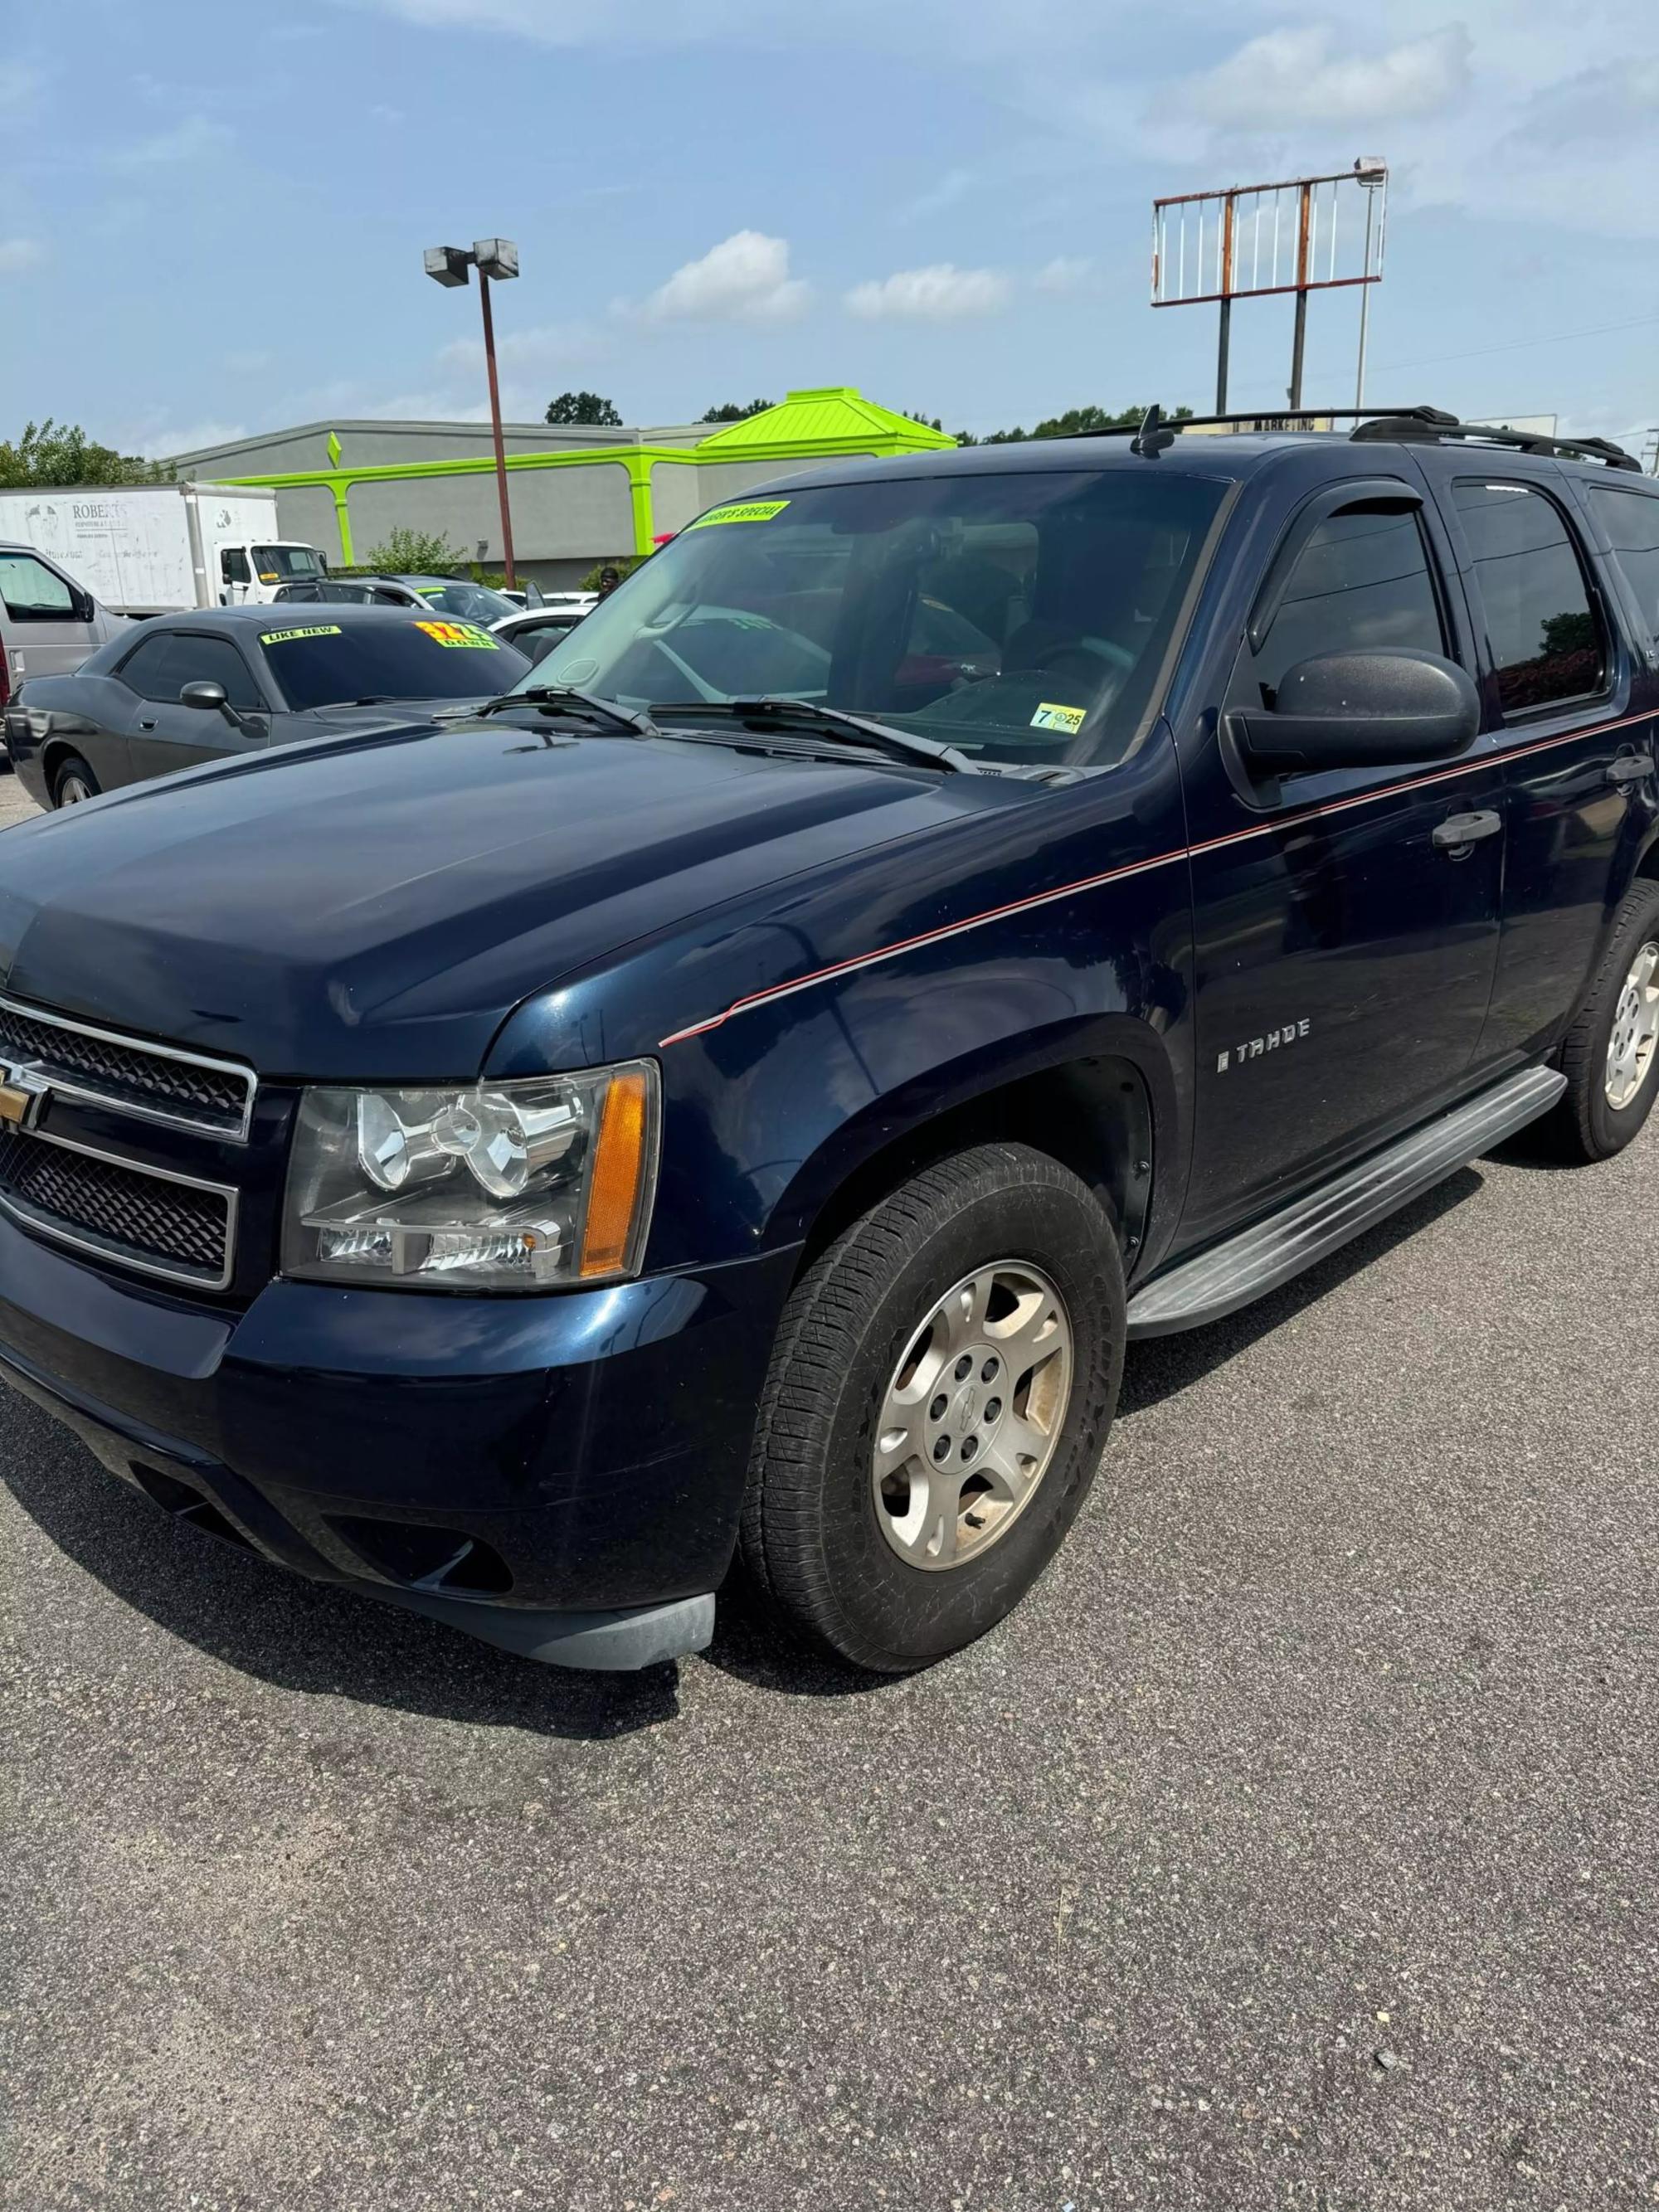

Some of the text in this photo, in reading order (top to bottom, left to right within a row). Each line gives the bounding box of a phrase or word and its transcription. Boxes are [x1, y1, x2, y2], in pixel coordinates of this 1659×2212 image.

[269, 627, 332, 641] LIKE NEW
[445, 639, 494, 648] DOWN
[1039, 710, 1082, 726] 7 25
[1236, 1018, 1310, 1062] TAHOE
